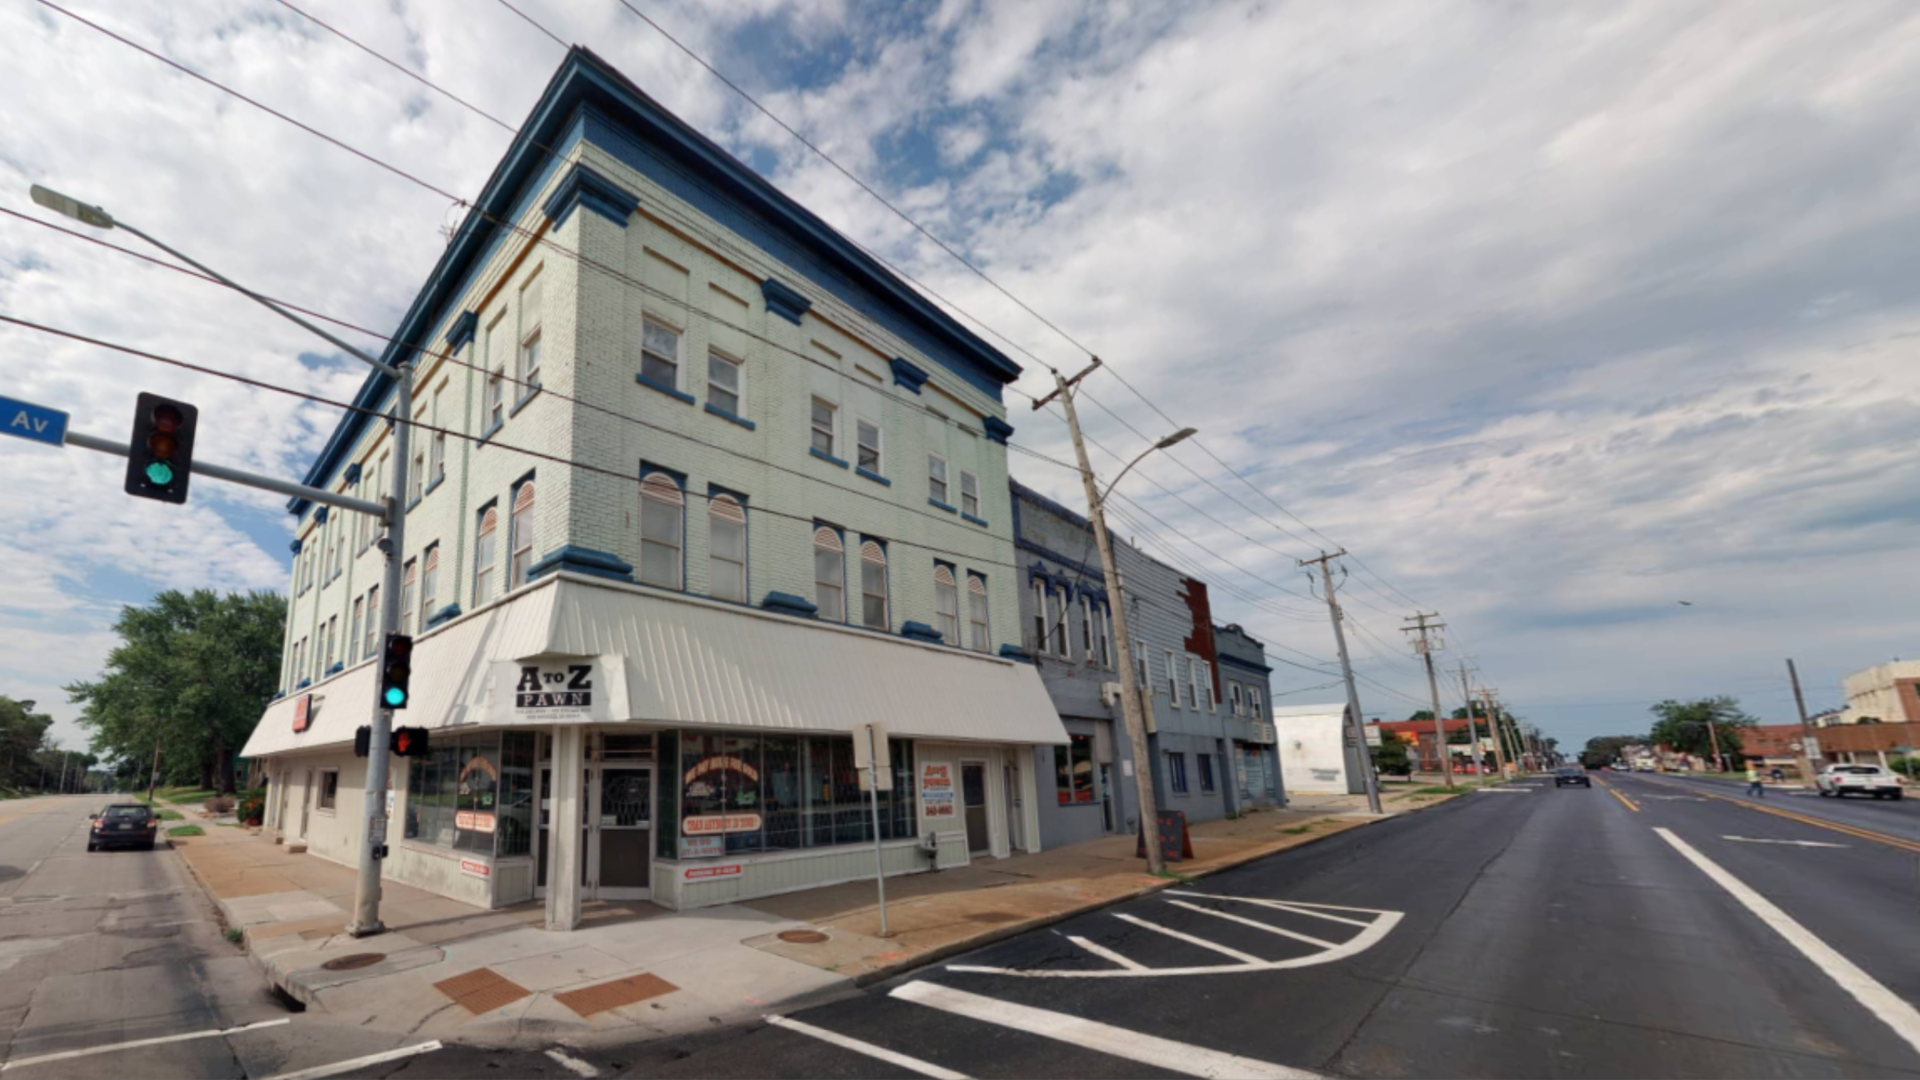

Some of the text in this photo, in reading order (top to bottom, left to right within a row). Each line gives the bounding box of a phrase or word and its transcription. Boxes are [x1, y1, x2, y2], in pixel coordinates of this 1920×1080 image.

[10, 410, 49, 433] Av
[517, 666, 542, 691] A
[567, 665, 592, 689] Z
[523, 693, 584, 706] PAWN
